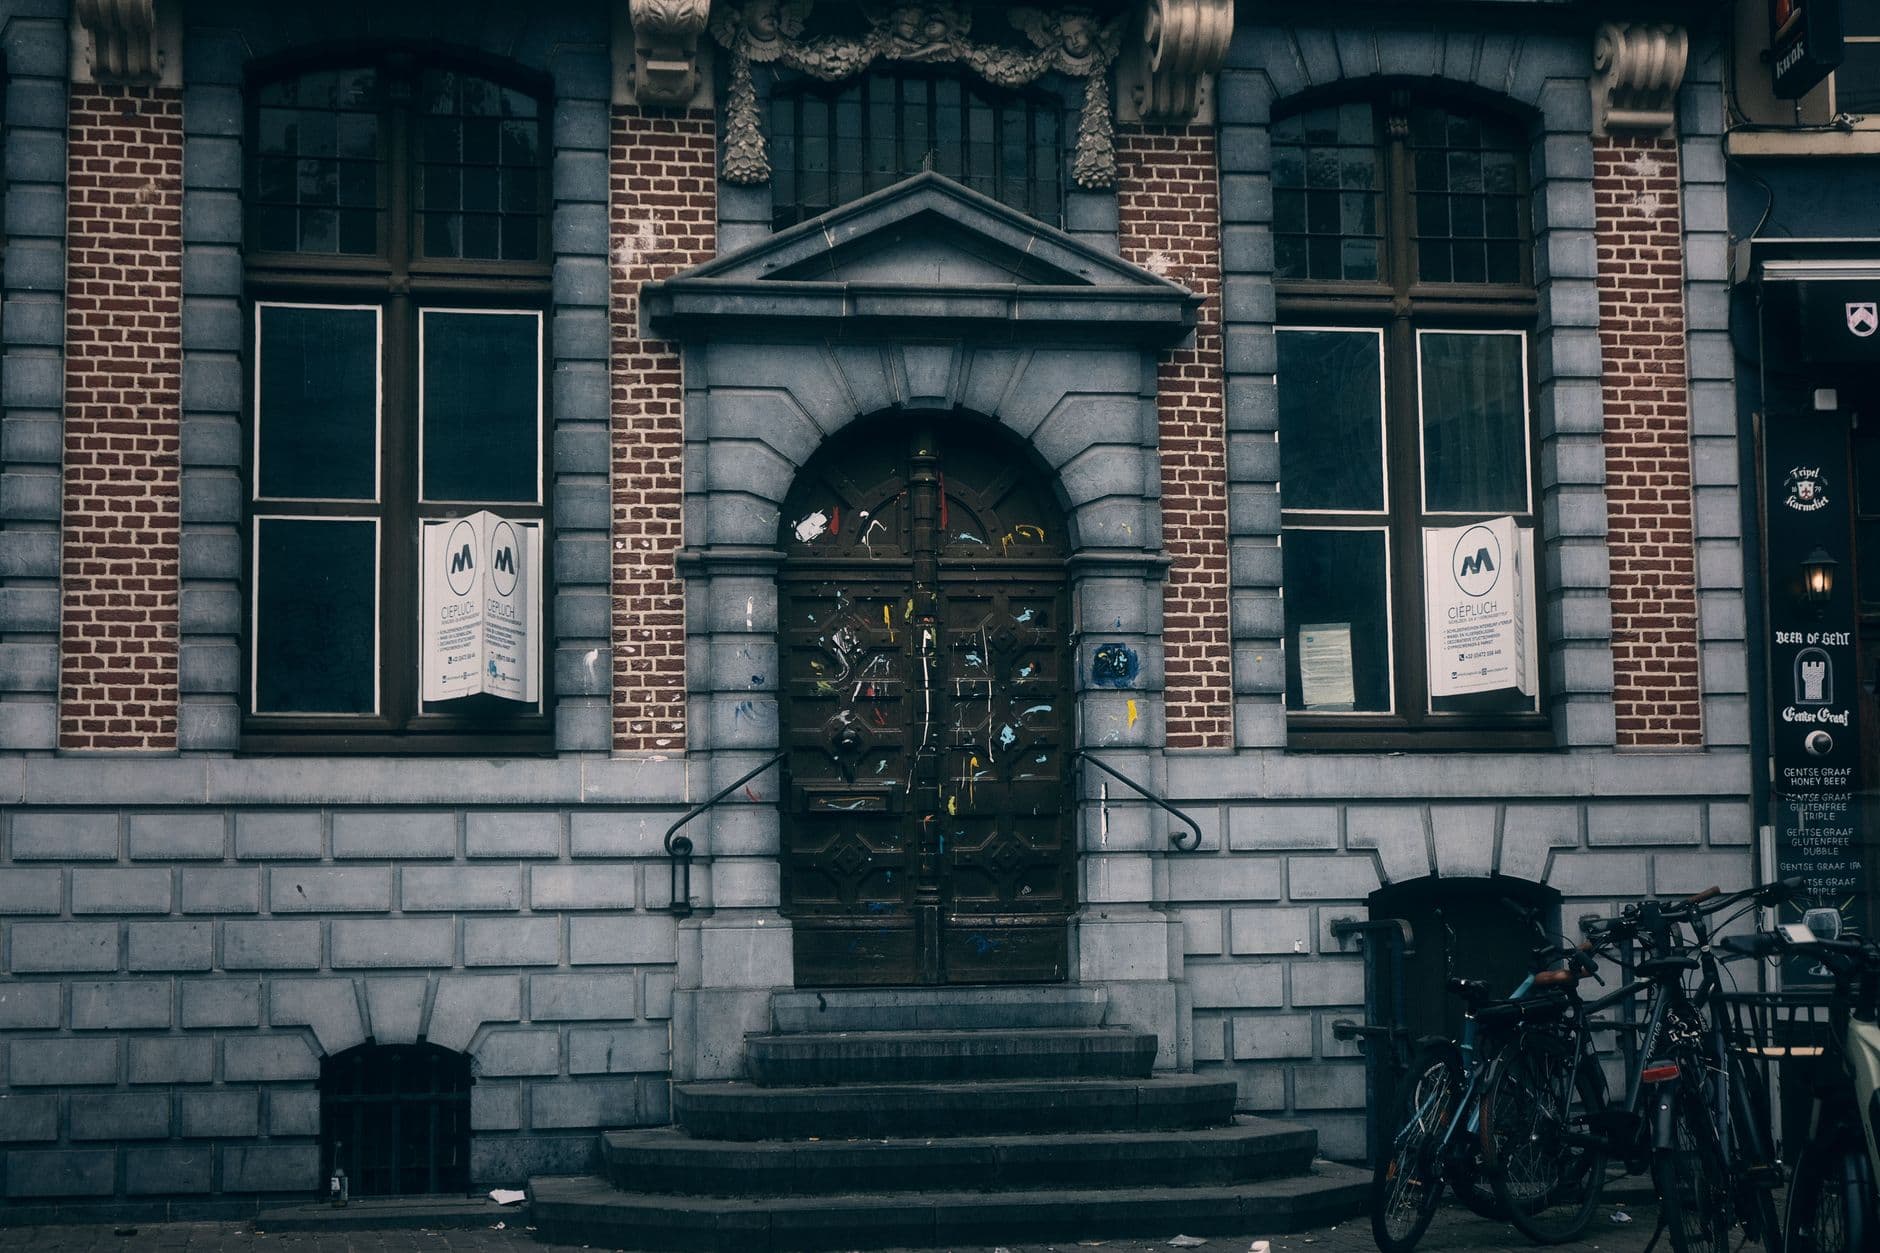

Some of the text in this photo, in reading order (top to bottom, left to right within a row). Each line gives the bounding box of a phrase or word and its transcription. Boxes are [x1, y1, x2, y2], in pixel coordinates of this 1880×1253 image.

[1789, 466, 1820, 479] Tripel
[1775, 631, 1803, 645] BEER
[1782, 706, 1850, 727] Gentse Graaf
[1784, 767, 1852, 777] GENTSE GRAAF
[1791, 777, 1847, 786] HONEY BEER
[1821, 793, 1853, 802] GRAAF
[1804, 812, 1836, 821] TRIPLE
[1823, 827, 1854, 837] GRAAF
[1791, 837, 1849, 847] GLUTENFREE
[1803, 847, 1839, 856] DUBBLE
[1780, 862, 1814, 871] GENTSE
[1817, 862, 1846, 871] GRAAF
[1825, 877, 1856, 887] GRAAF
[1807, 887, 1837, 896] TRIPLE
